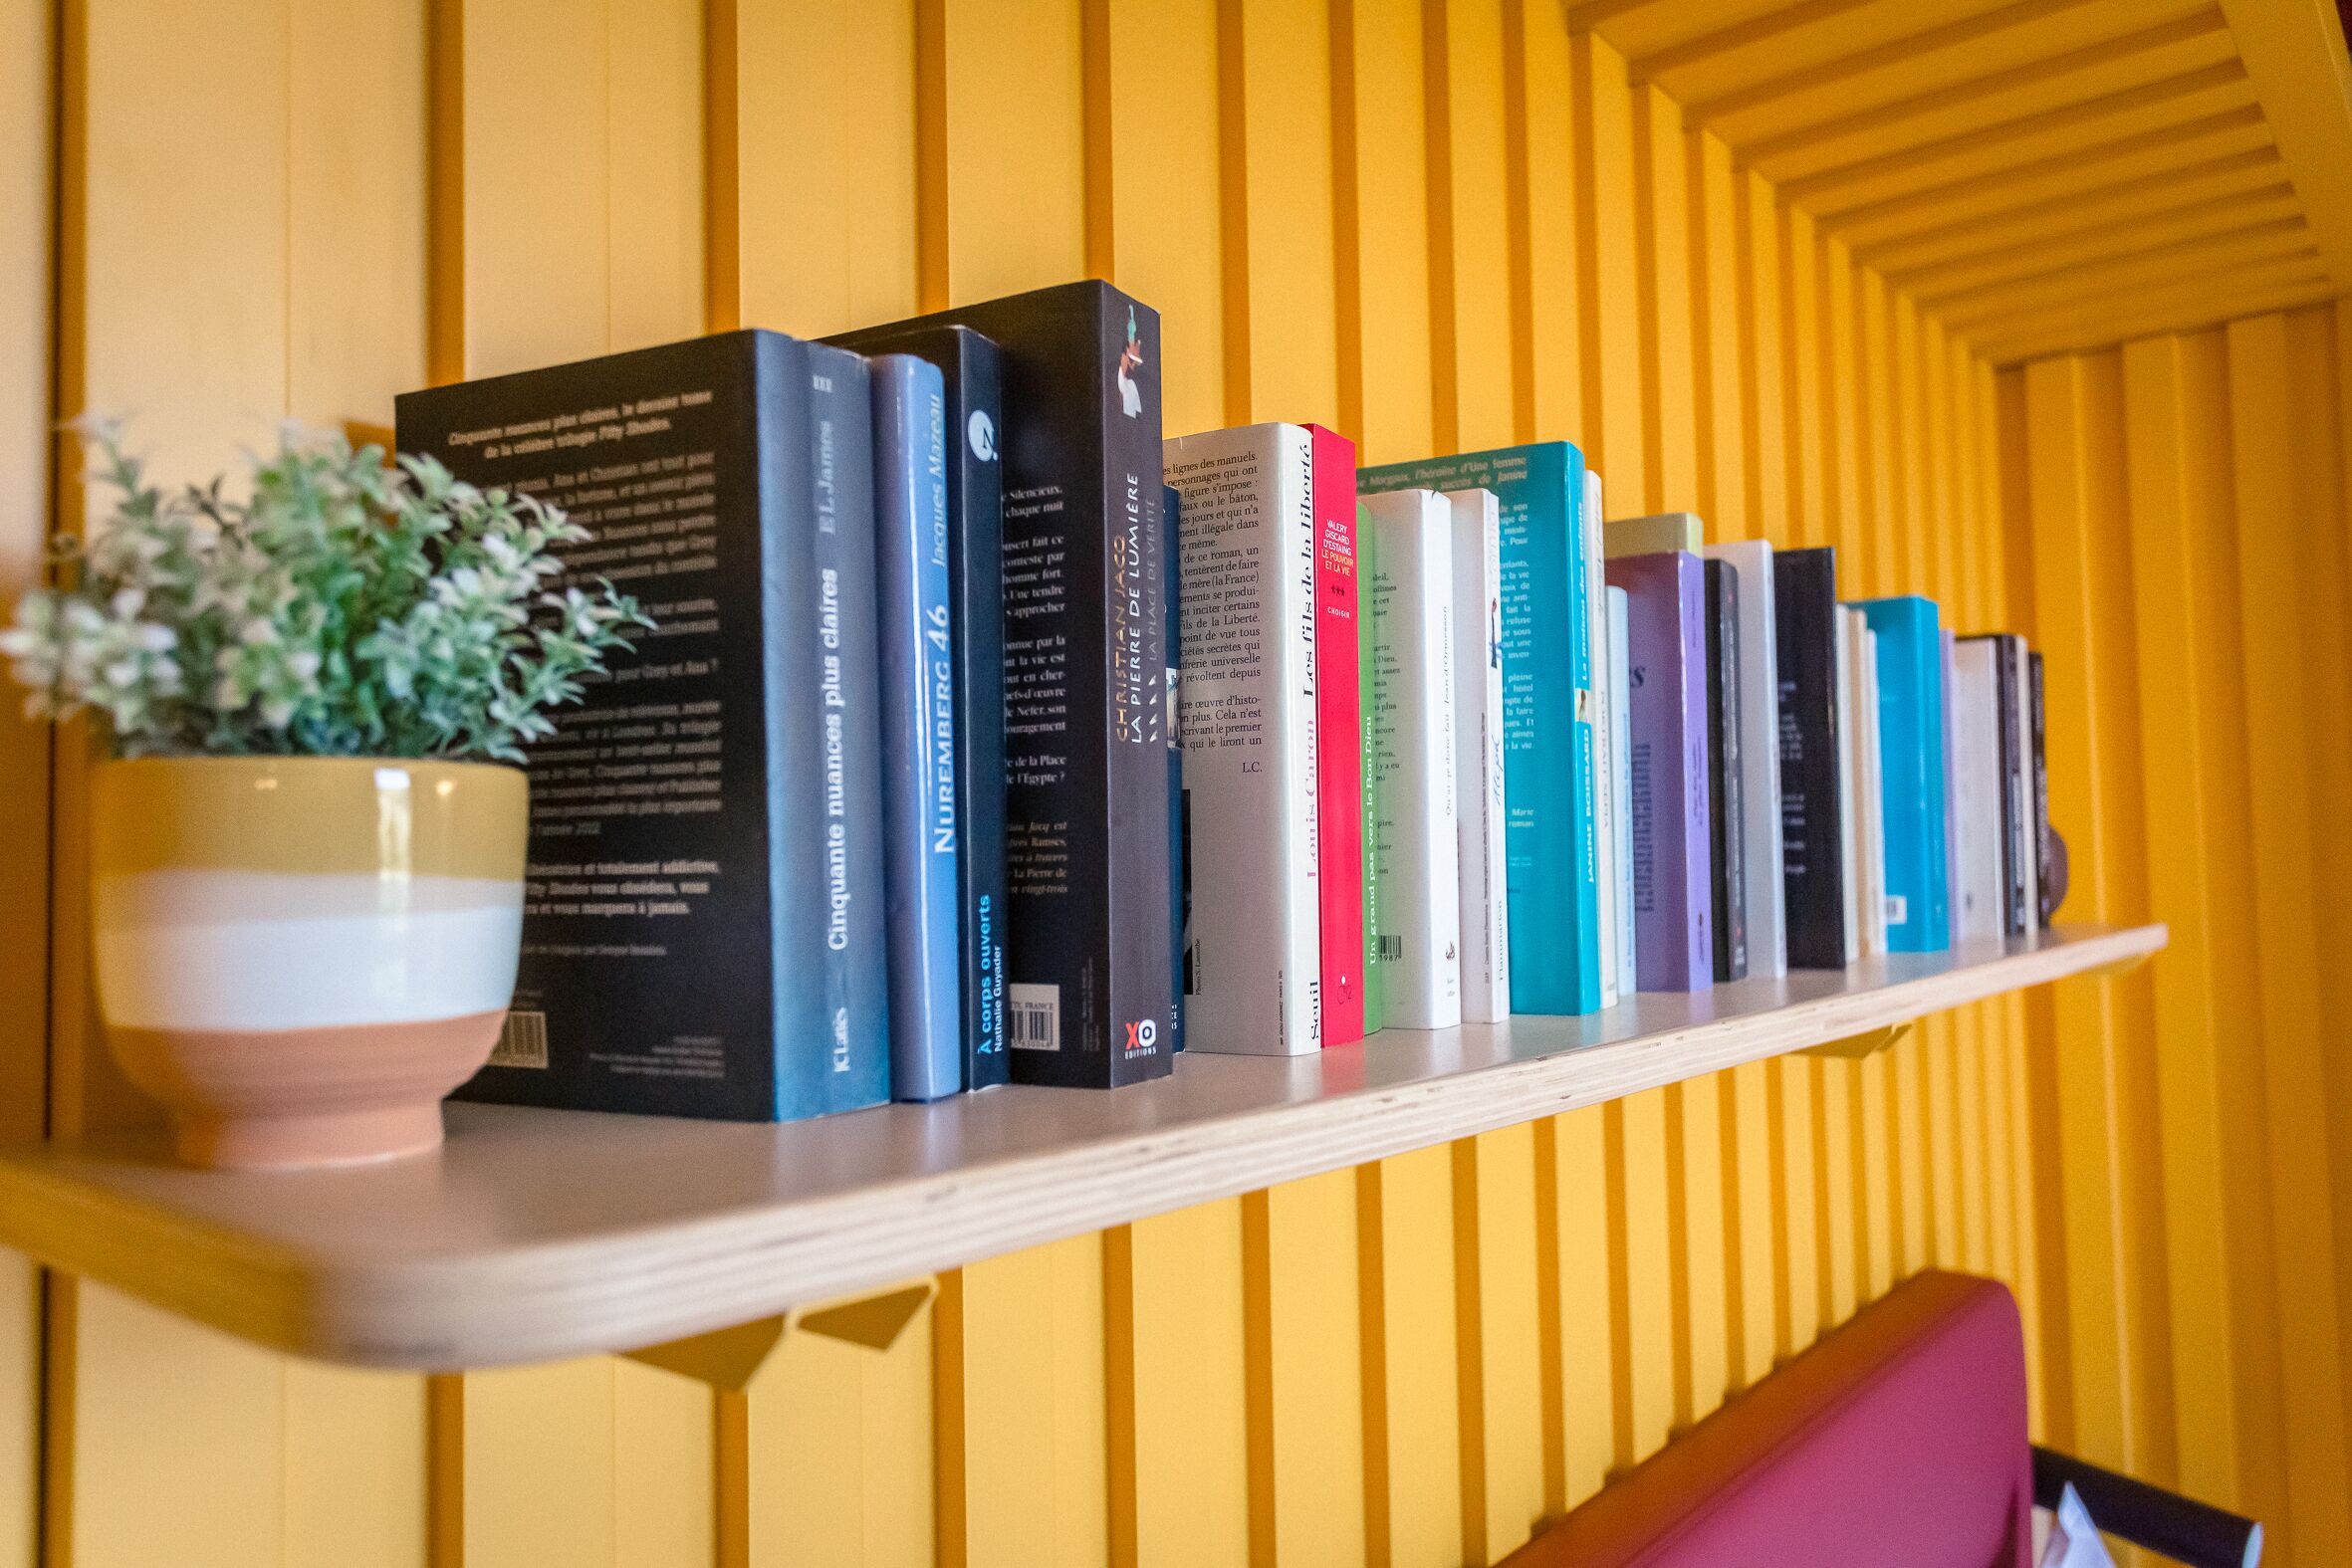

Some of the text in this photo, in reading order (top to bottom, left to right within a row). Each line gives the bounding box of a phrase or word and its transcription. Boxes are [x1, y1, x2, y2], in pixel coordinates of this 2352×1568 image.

[1173, 451, 1258, 476] lignes des manuels.
[927, 394, 946, 568] Jacques Mazeau
[1167, 465, 1258, 487] personnages qui ont
[1184, 480, 1252, 500] figure s'impose
[1217, 495, 1225, 506] le
[1229, 492, 1258, 505] bâton,
[1191, 504, 1259, 526] jours et qui n'a
[1179, 517, 1259, 538] ment illégale dans
[1326, 520, 1347, 534] VALERY
[1189, 539, 1217, 550] même.
[1324, 530, 1349, 546] GISCARD
[1184, 547, 1259, 563] de ce roman, un
[1323, 539, 1352, 556] D'ESTAING
[1048, 553, 1064, 565] par
[1321, 549, 1354, 567] LE POUVOIR
[1146, 560, 1156, 580] DE
[1185, 560, 1259, 576] tentèrent de faire
[1299, 444, 1314, 699] Les fils de la liberté
[1325, 560, 1350, 576] ET LA VIE
[1189, 571, 1259, 588] mère (la France)
[1225, 586, 1259, 601] produi-
[1126, 473, 1141, 744] LA PIERRE DE LUMIÈRE
[1146, 587, 1157, 635] PLACE
[1193, 600, 1259, 615] inciter certains
[1327, 606, 1350, 618] CHOISIR
[926, 604, 948, 652] 46
[1197, 614, 1260, 628] de la Liberté.
[1113, 534, 1128, 743] CHRISTIAN JACQ
[1180, 632, 1202, 644] point
[1206, 631, 1216, 641] de
[1220, 630, 1236, 639] vue
[1147, 641, 1157, 661] LA
[1207, 640, 1260, 654] secrètes qui
[1212, 655, 1261, 667] universelle
[1187, 668, 1261, 683] révoltent depuis
[1581, 663, 1587, 681] La
[1195, 695, 1261, 708] œuvre d'histo-
[1192, 709, 1261, 726] plus. Cela n'est
[1216, 723, 1262, 736] le premier
[1190, 740, 1204, 752] qui
[1209, 738, 1216, 748] le
[1220, 736, 1246, 747] liront
[821, 567, 851, 951] Cinquante nuances plus claires
[1243, 762, 1262, 774] L.C.
[1305, 720, 1316, 877] Louis Caron
[1367, 792, 1374, 806] le
[980, 894, 991, 968] ouverts
[1370, 942, 1376, 966] Un
[980, 974, 995, 1034] corps
[994, 946, 1004, 1052] Nathalie Guyader
[1309, 980, 1318, 1040] Seuil
[1125, 1019, 1156, 1049] XO
